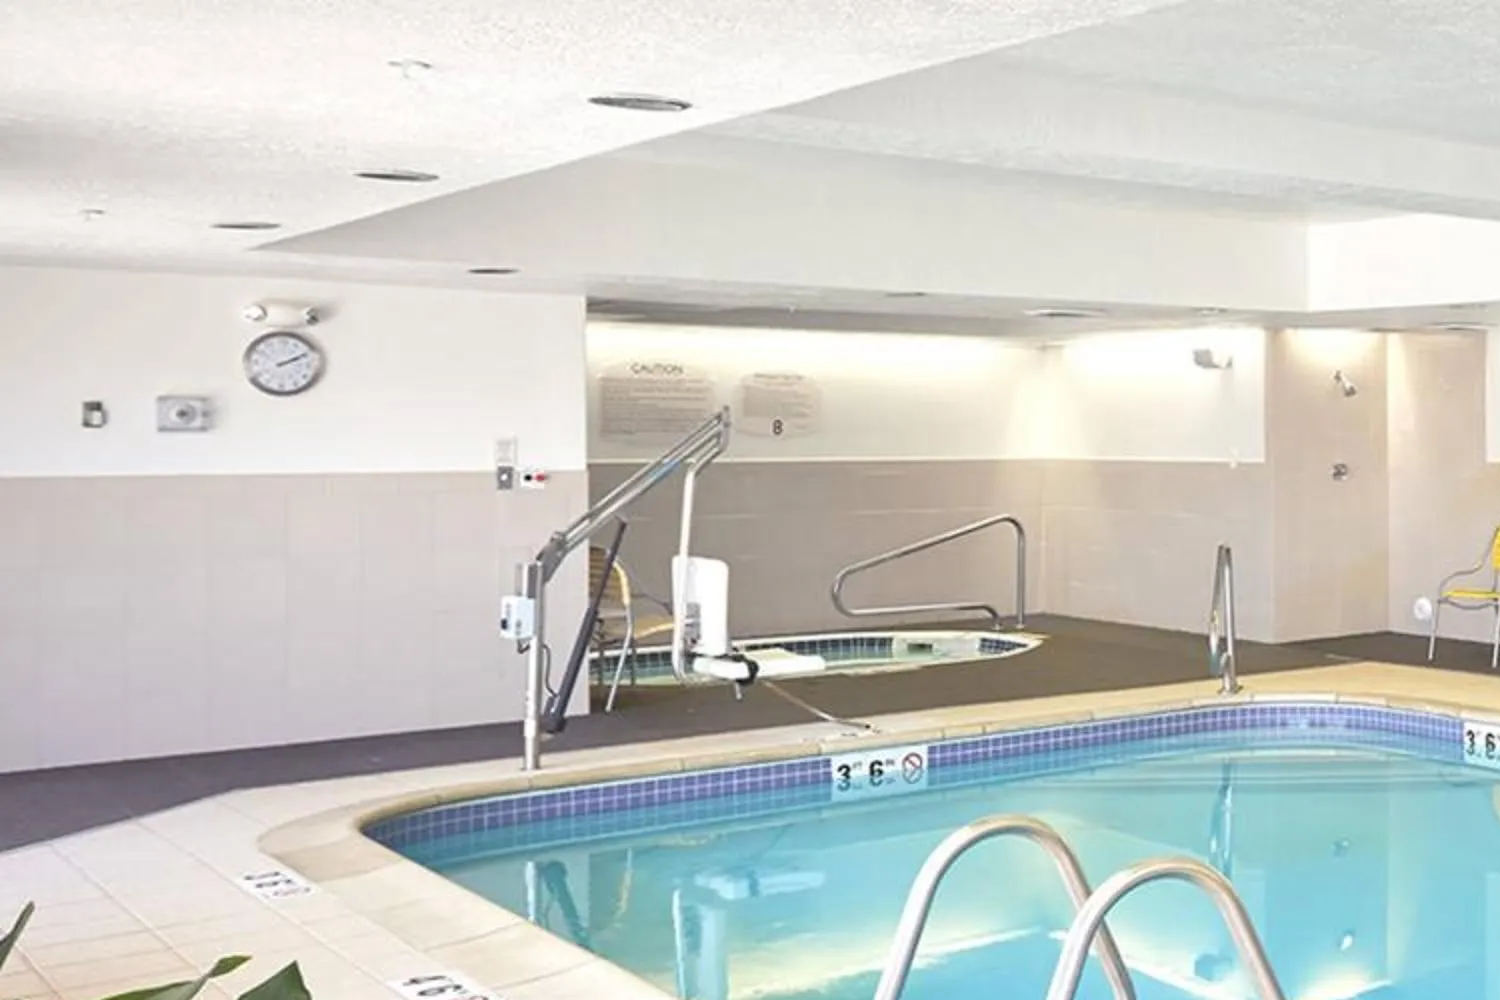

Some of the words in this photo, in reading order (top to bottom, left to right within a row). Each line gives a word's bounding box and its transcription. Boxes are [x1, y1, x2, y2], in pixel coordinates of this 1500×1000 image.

[630, 363, 685, 376] CAUTION
[771, 419, 783, 436] 8
[837, 763, 852, 781] 3
[869, 759, 884, 778] 6
